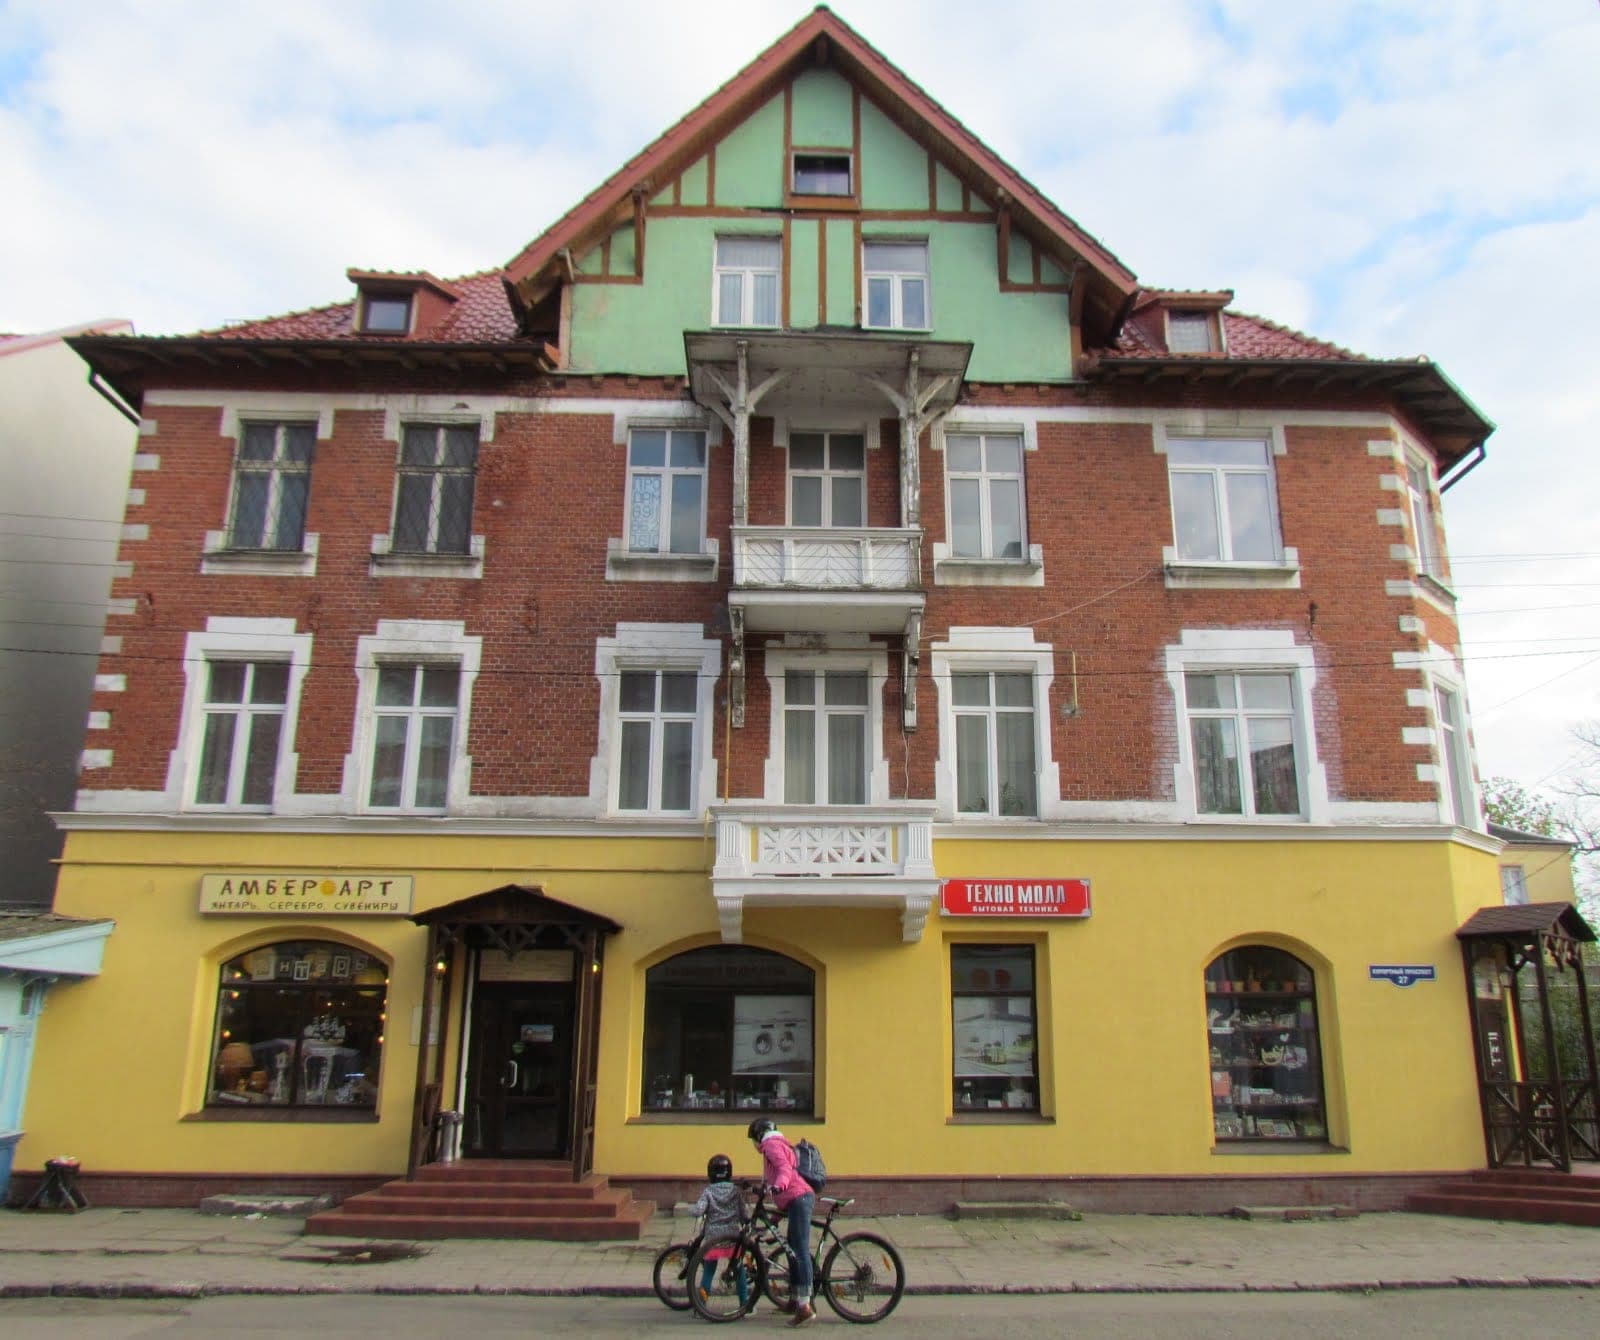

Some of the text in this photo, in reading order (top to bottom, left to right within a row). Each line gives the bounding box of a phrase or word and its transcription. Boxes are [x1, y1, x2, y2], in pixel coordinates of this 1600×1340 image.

[220, 879, 394, 897] АМБЕР АРТ
[965, 884, 1066, 904] ТЕХНО МОЛЛ
[334, 902, 399, 912] СУВЕНИРЫ
[1019, 905, 1060, 913] ТЕХНИКА
[1398, 976, 1408, 984] 27
